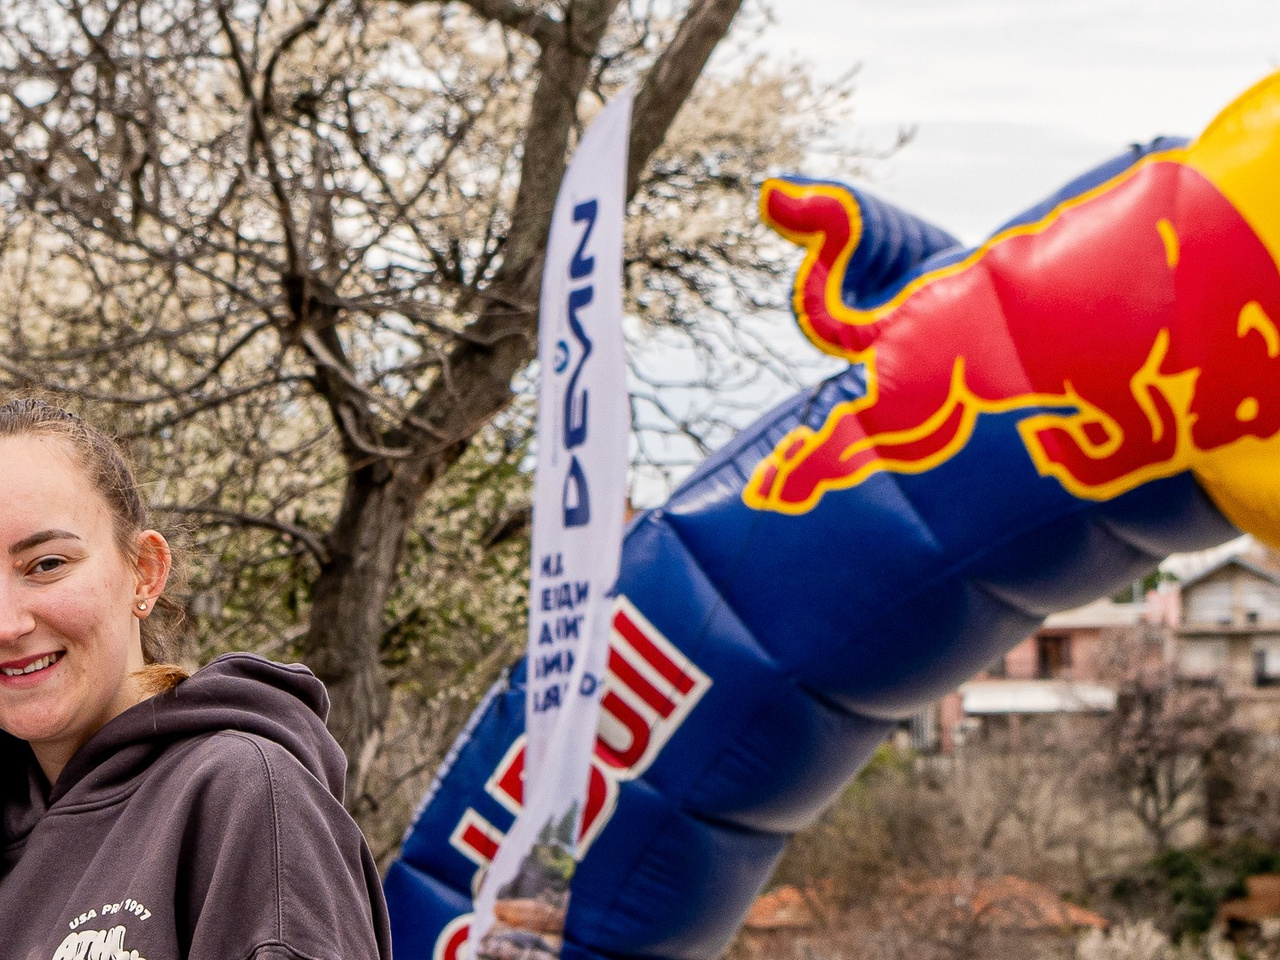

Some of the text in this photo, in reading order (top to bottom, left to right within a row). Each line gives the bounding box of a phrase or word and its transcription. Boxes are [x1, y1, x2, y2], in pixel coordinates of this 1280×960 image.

[561, 198, 600, 529] DEVIN
[69, 909, 97, 930] USA
[124, 898, 152, 921] 1997
